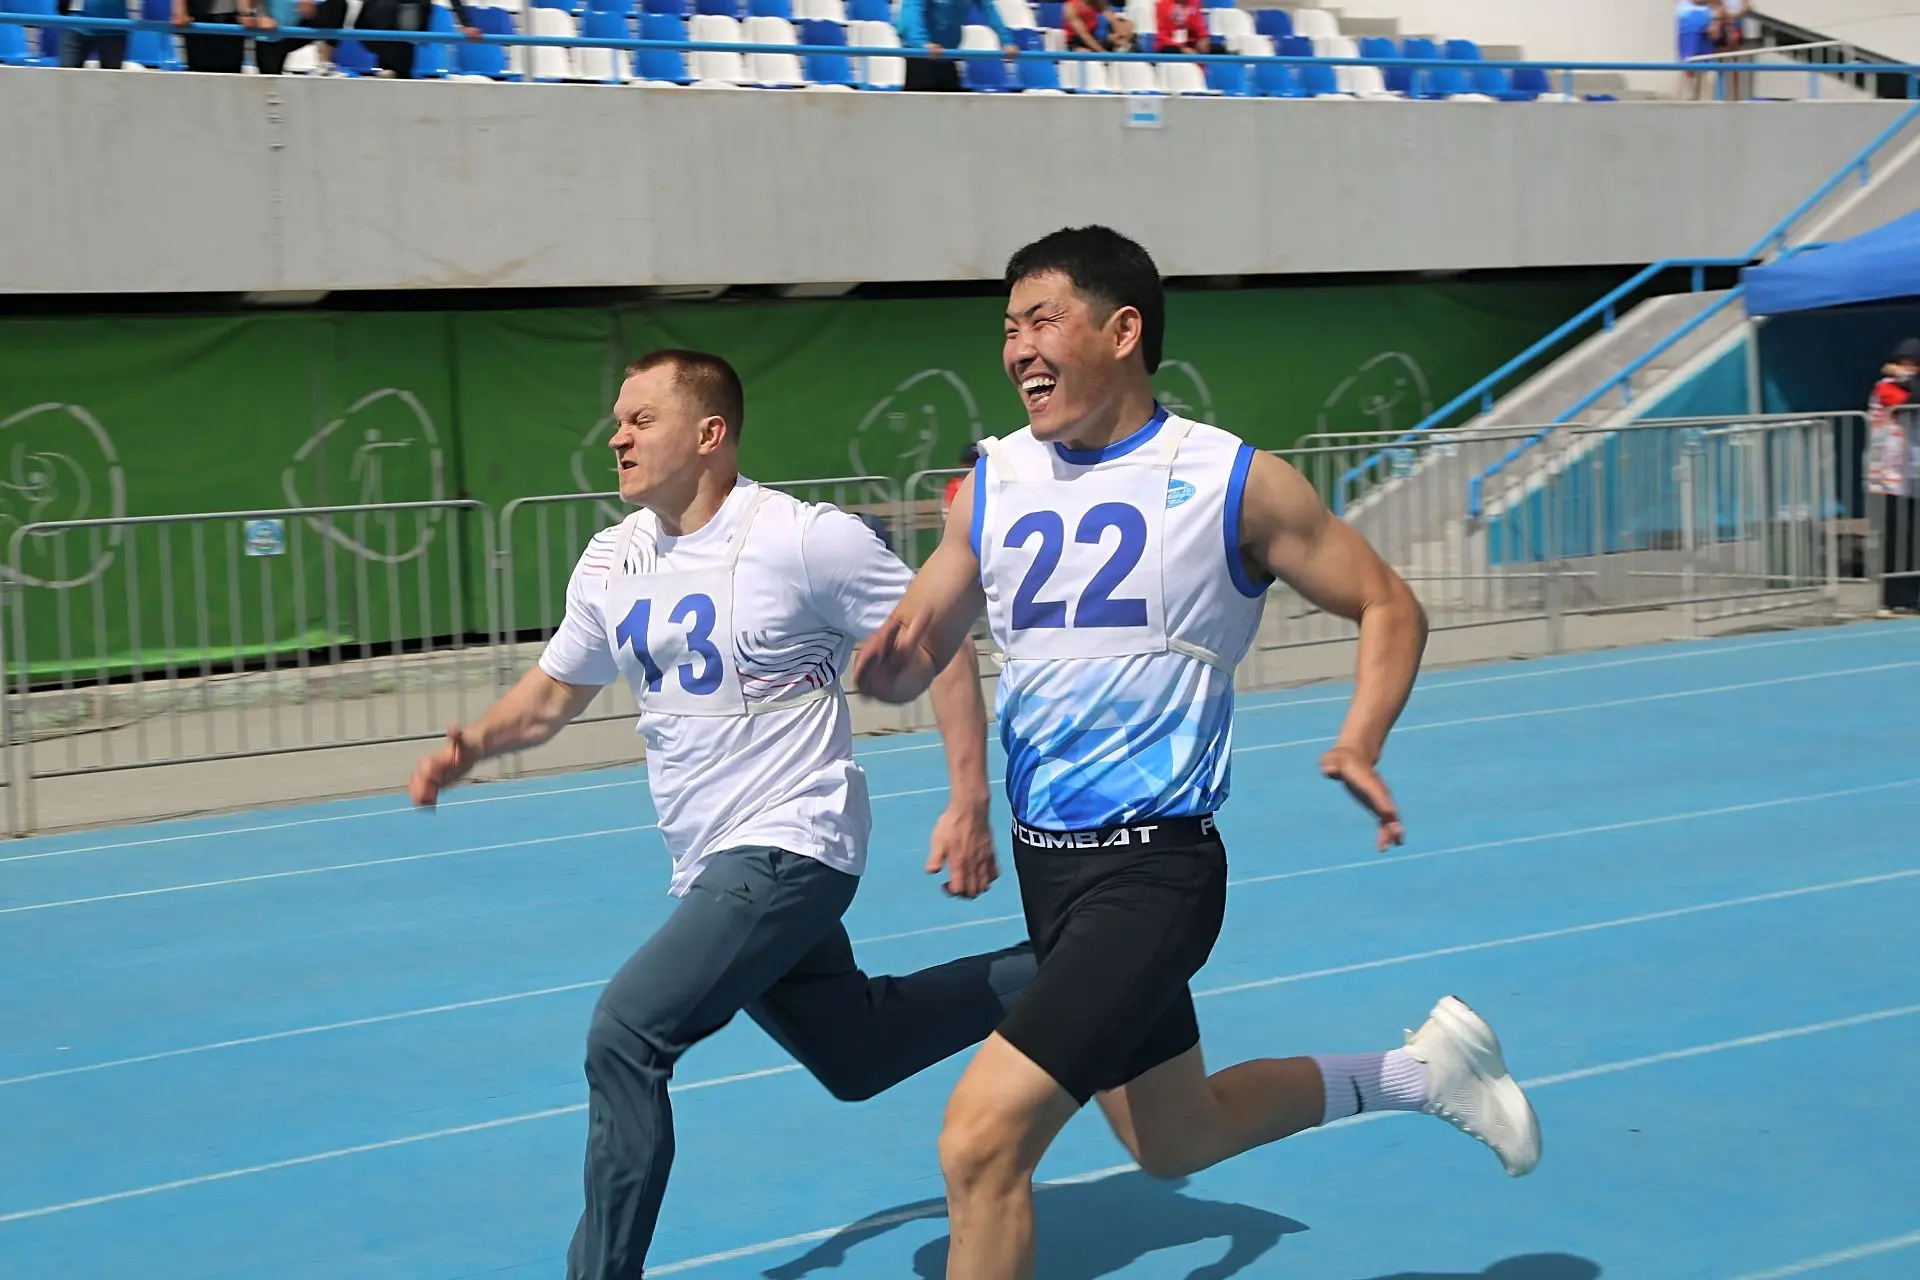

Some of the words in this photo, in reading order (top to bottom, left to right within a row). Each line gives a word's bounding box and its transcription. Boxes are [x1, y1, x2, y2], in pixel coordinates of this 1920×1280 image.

[1003, 502, 1148, 631] 22
[616, 593, 724, 696] 13
[1018, 825, 1158, 849] COMBAT
